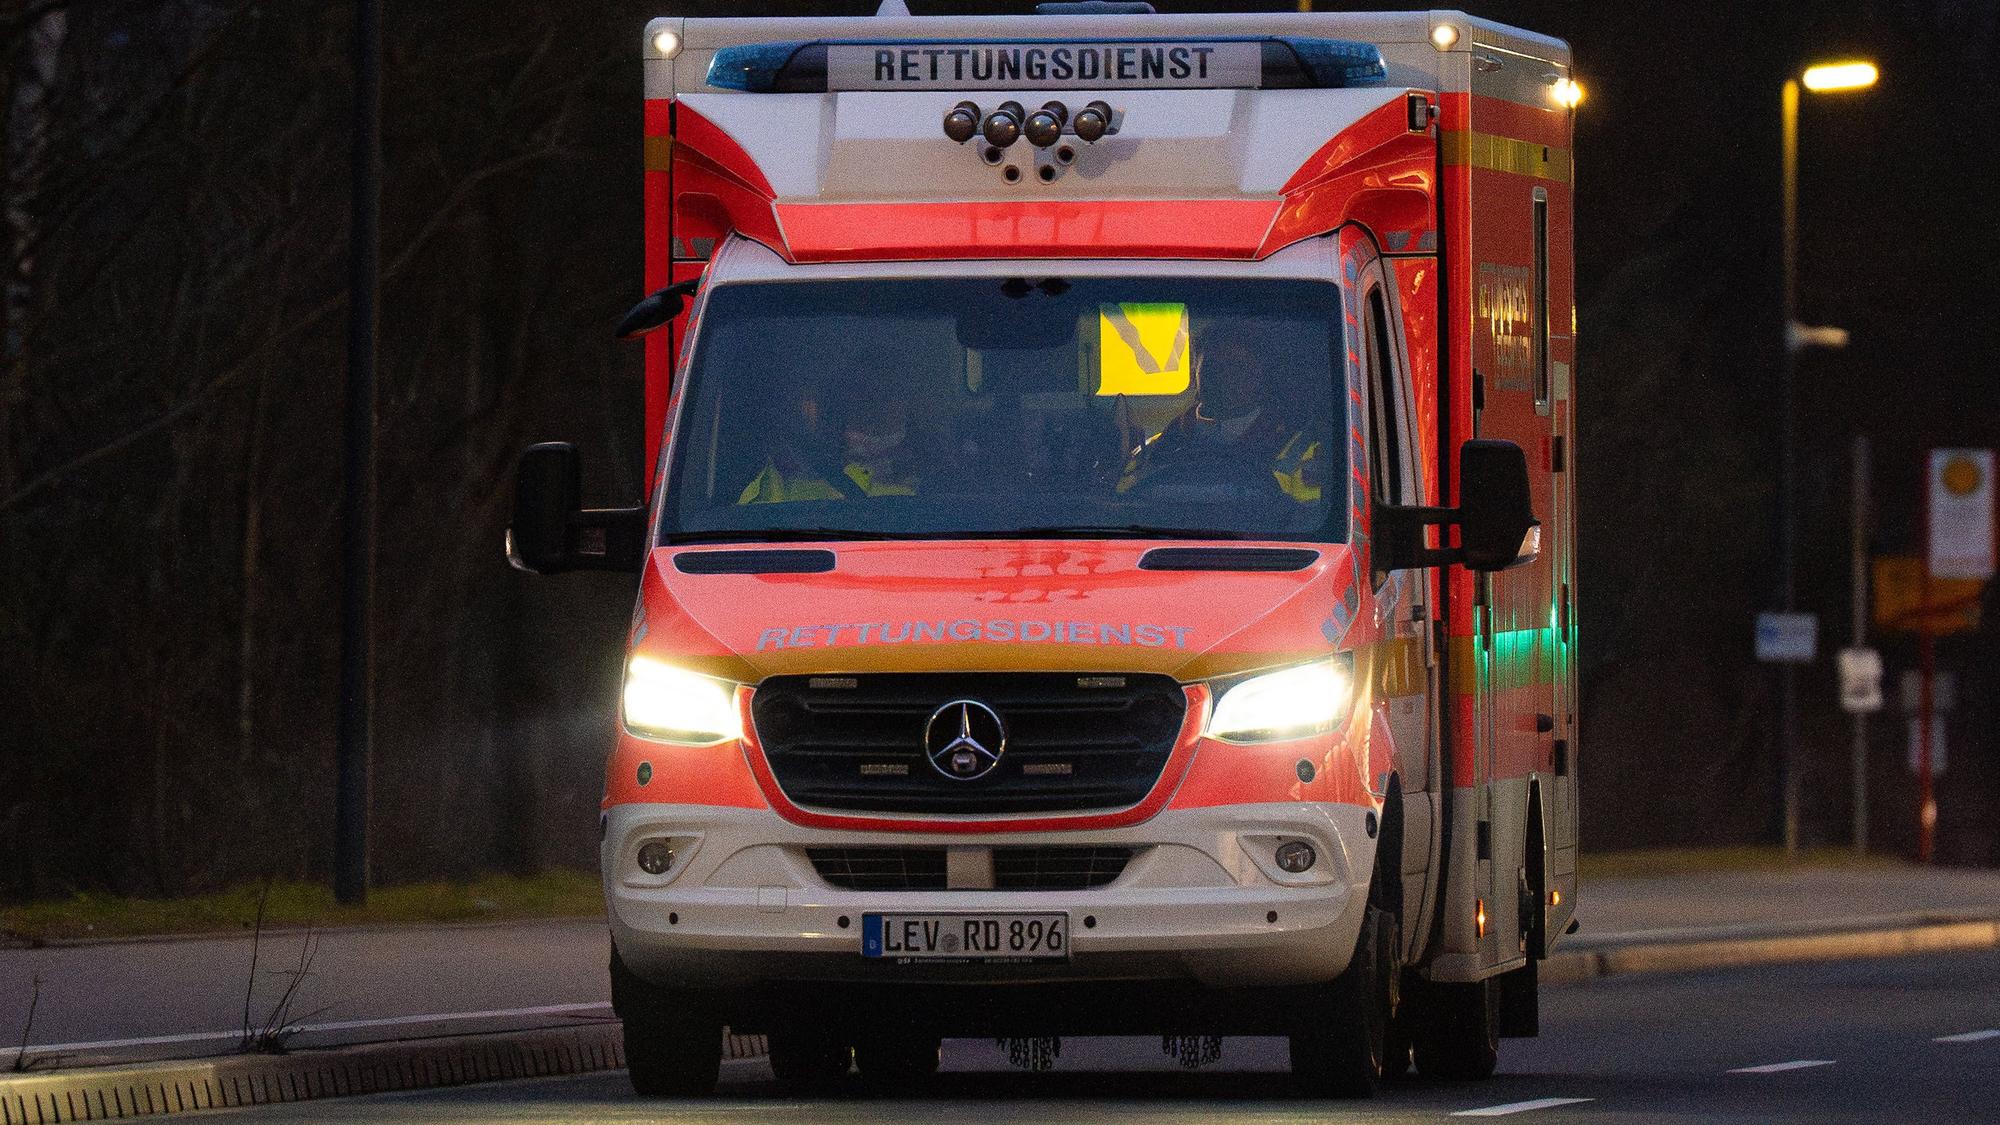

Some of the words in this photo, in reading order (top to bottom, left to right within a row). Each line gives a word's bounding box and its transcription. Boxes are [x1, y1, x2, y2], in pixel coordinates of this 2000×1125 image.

[874, 48, 1214, 81] RETTUNGSDIENST
[756, 619, 1194, 651] RETTUNGSDIENST
[884, 920, 939, 951] LEV
[963, 920, 1000, 951] RD
[1009, 919, 1062, 951] 896
